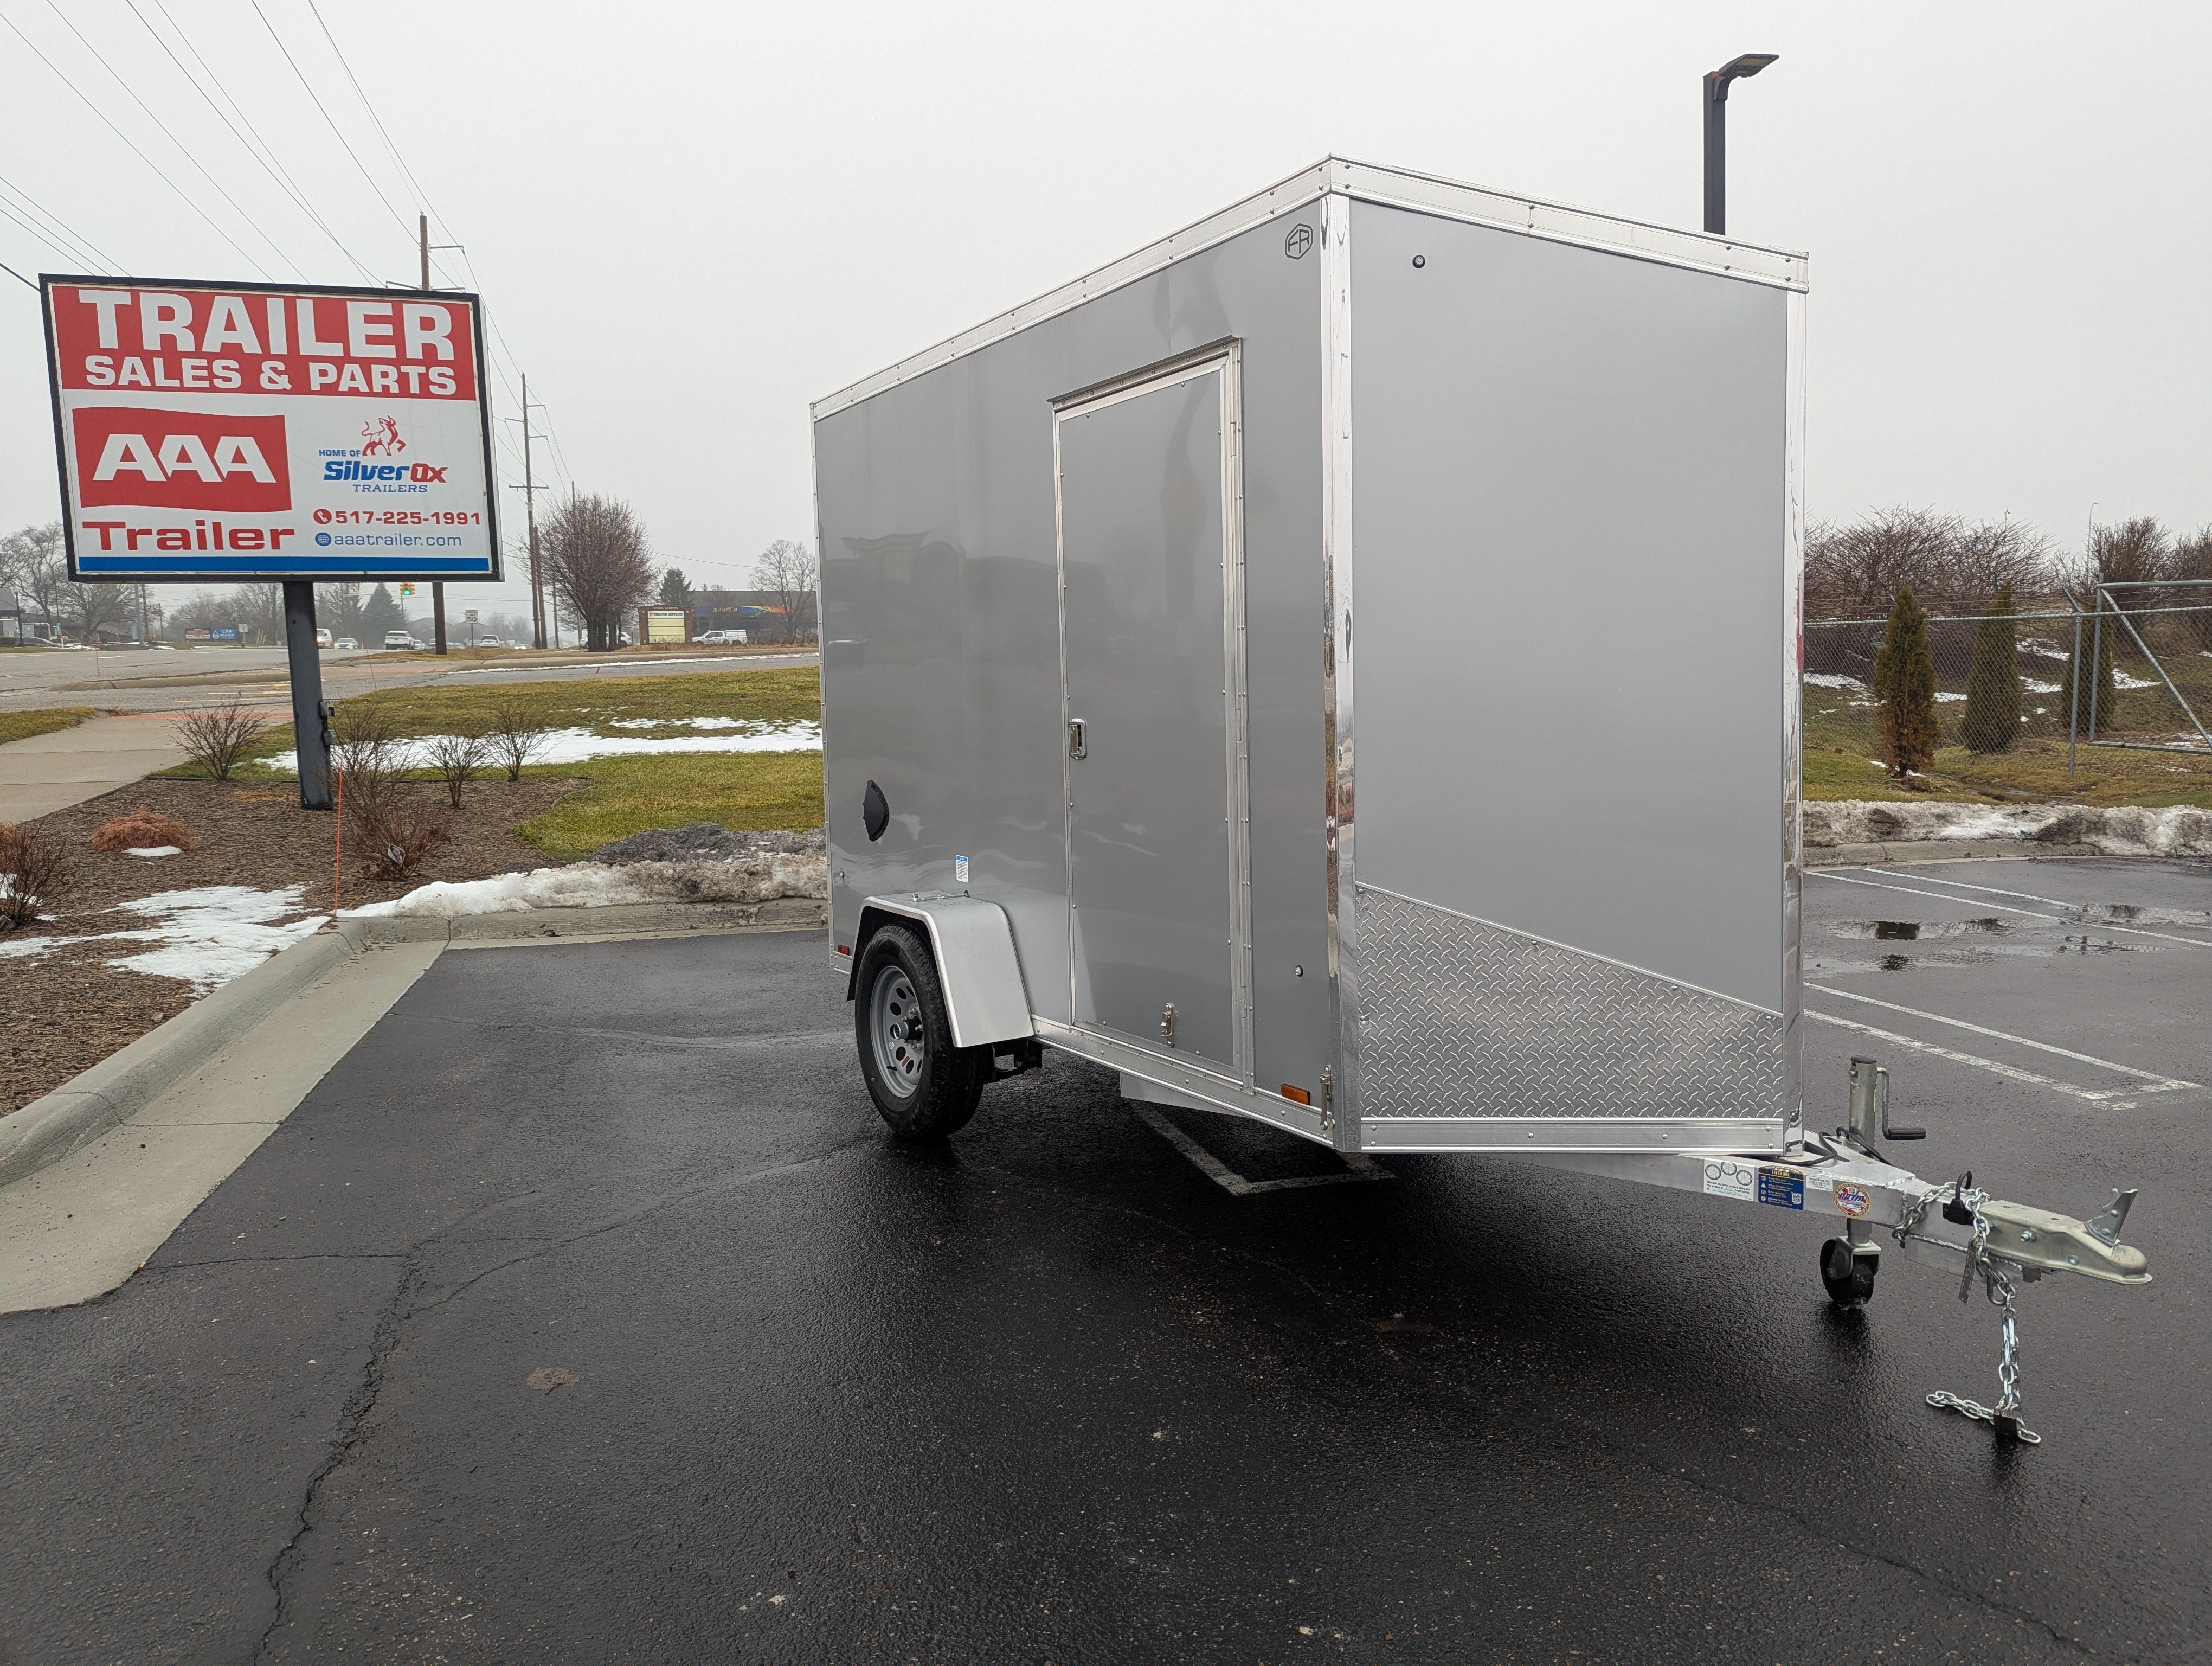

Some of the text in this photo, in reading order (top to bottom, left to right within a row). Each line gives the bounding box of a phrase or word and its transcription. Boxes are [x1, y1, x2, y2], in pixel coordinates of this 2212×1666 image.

[79, 289, 455, 361] TRAILER
[85, 355, 456, 395] SALES & PARTS
[92, 434, 277, 483] AAA
[352, 484, 428, 493] TRAILERS
[335, 511, 480, 526] 517-225-1991
[82, 520, 295, 550] Trailer
[334, 533, 462, 546] aaatrailer.com
